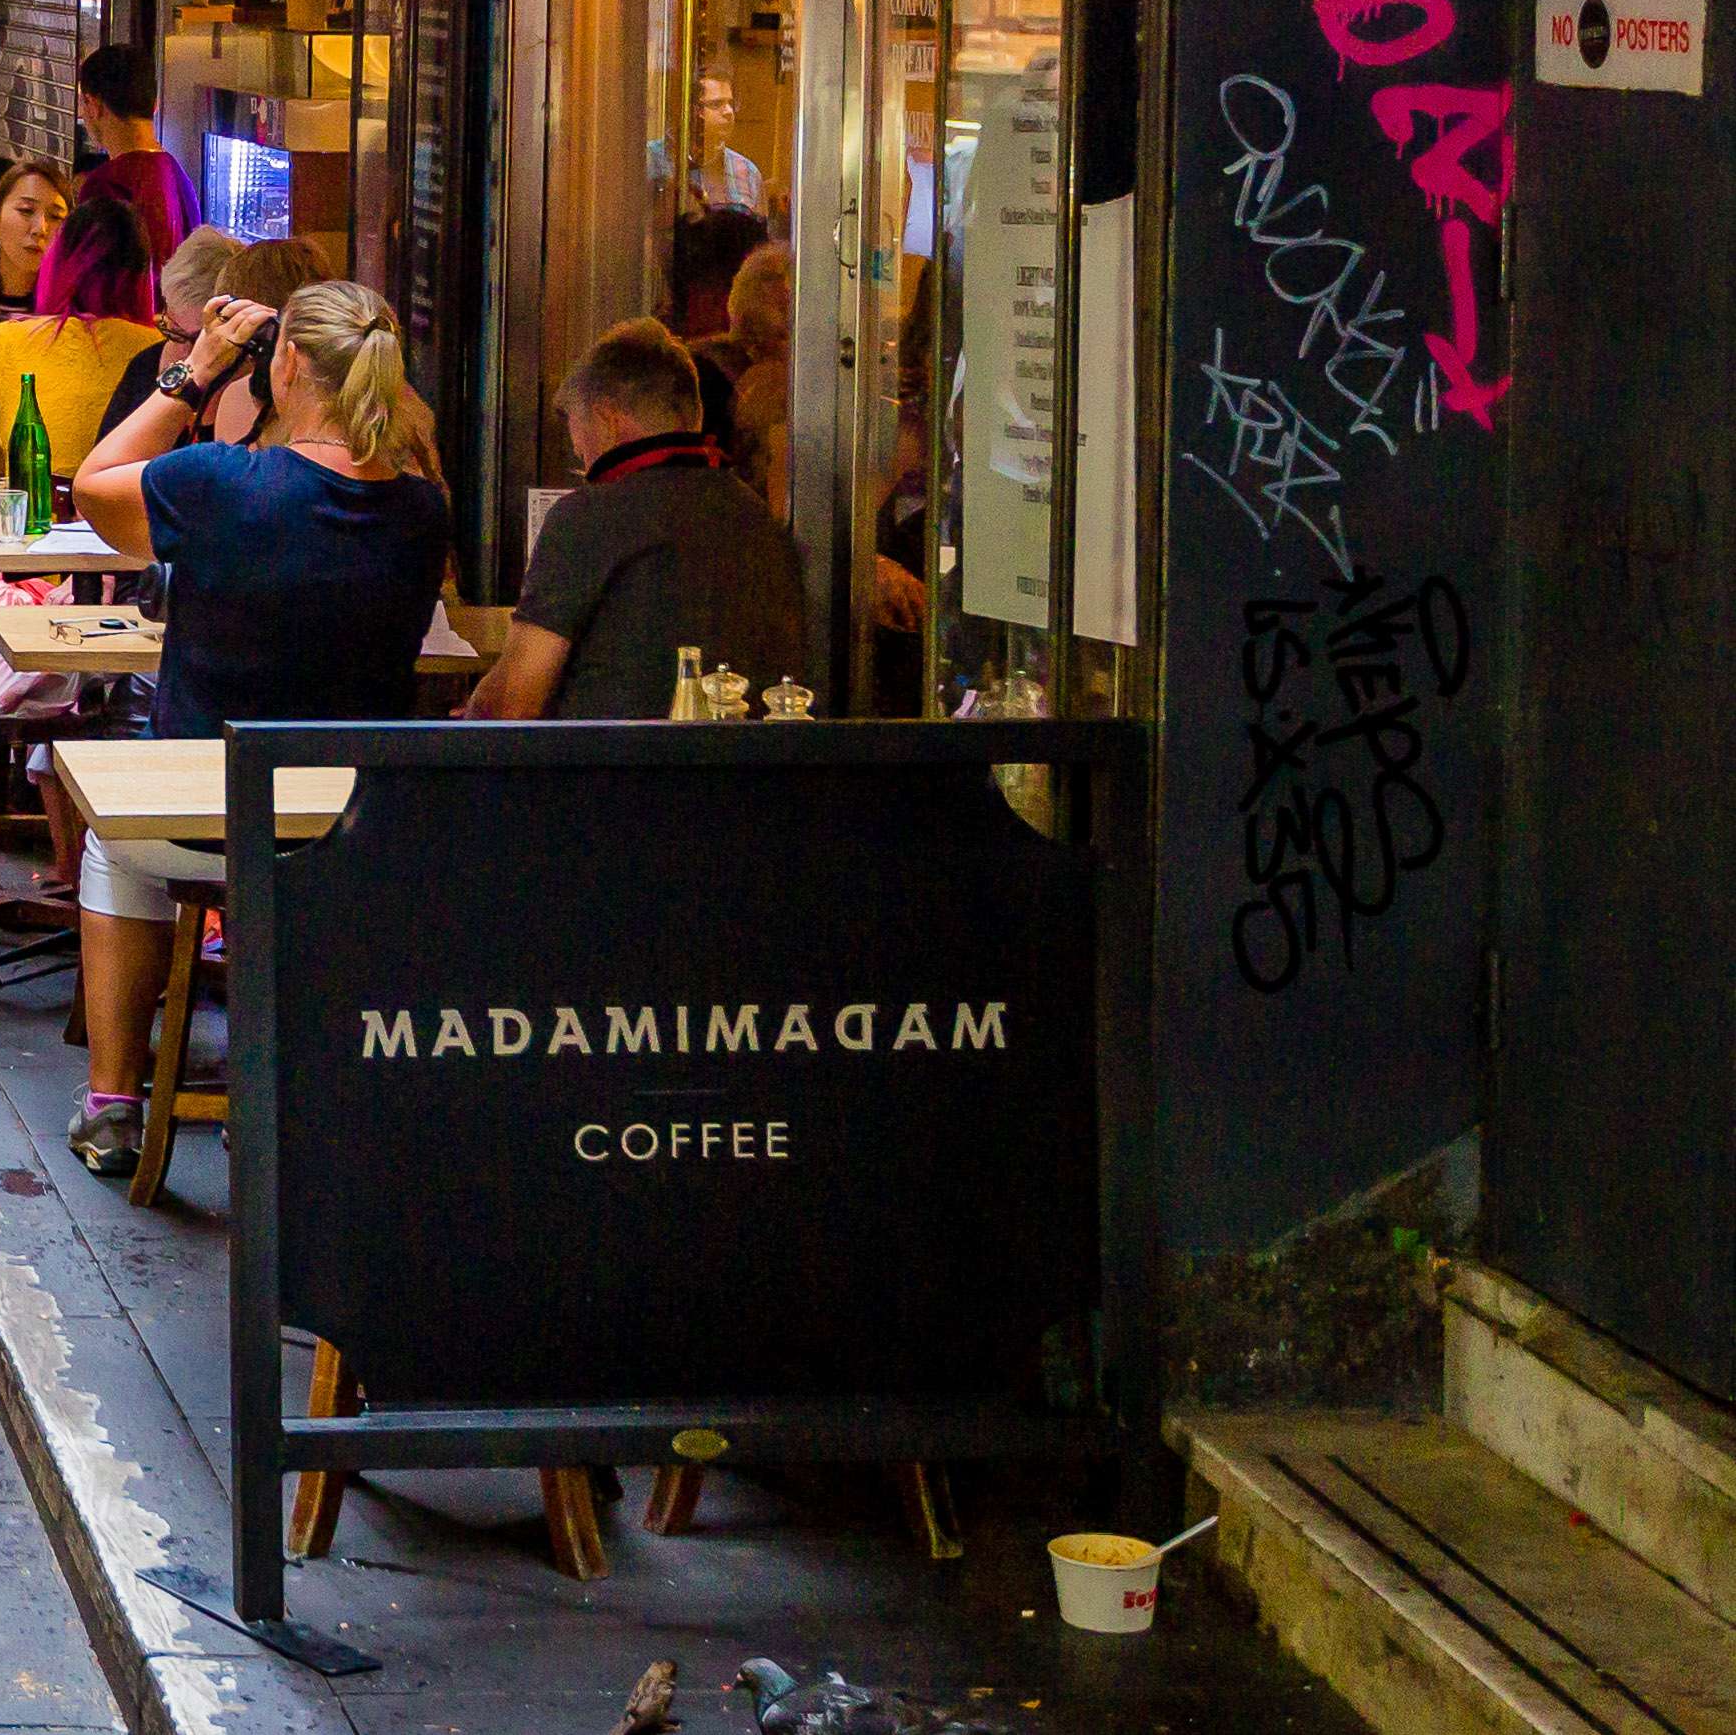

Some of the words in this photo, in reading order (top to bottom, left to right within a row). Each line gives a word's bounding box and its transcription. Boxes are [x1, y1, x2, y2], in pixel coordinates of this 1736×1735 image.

[1551, 15, 1574, 46] NO
[1616, 18, 1691, 54] POSTERS
[360, 1001, 1010, 1060] MADAMIMADAM
[573, 1122, 791, 1161] COFFEE
